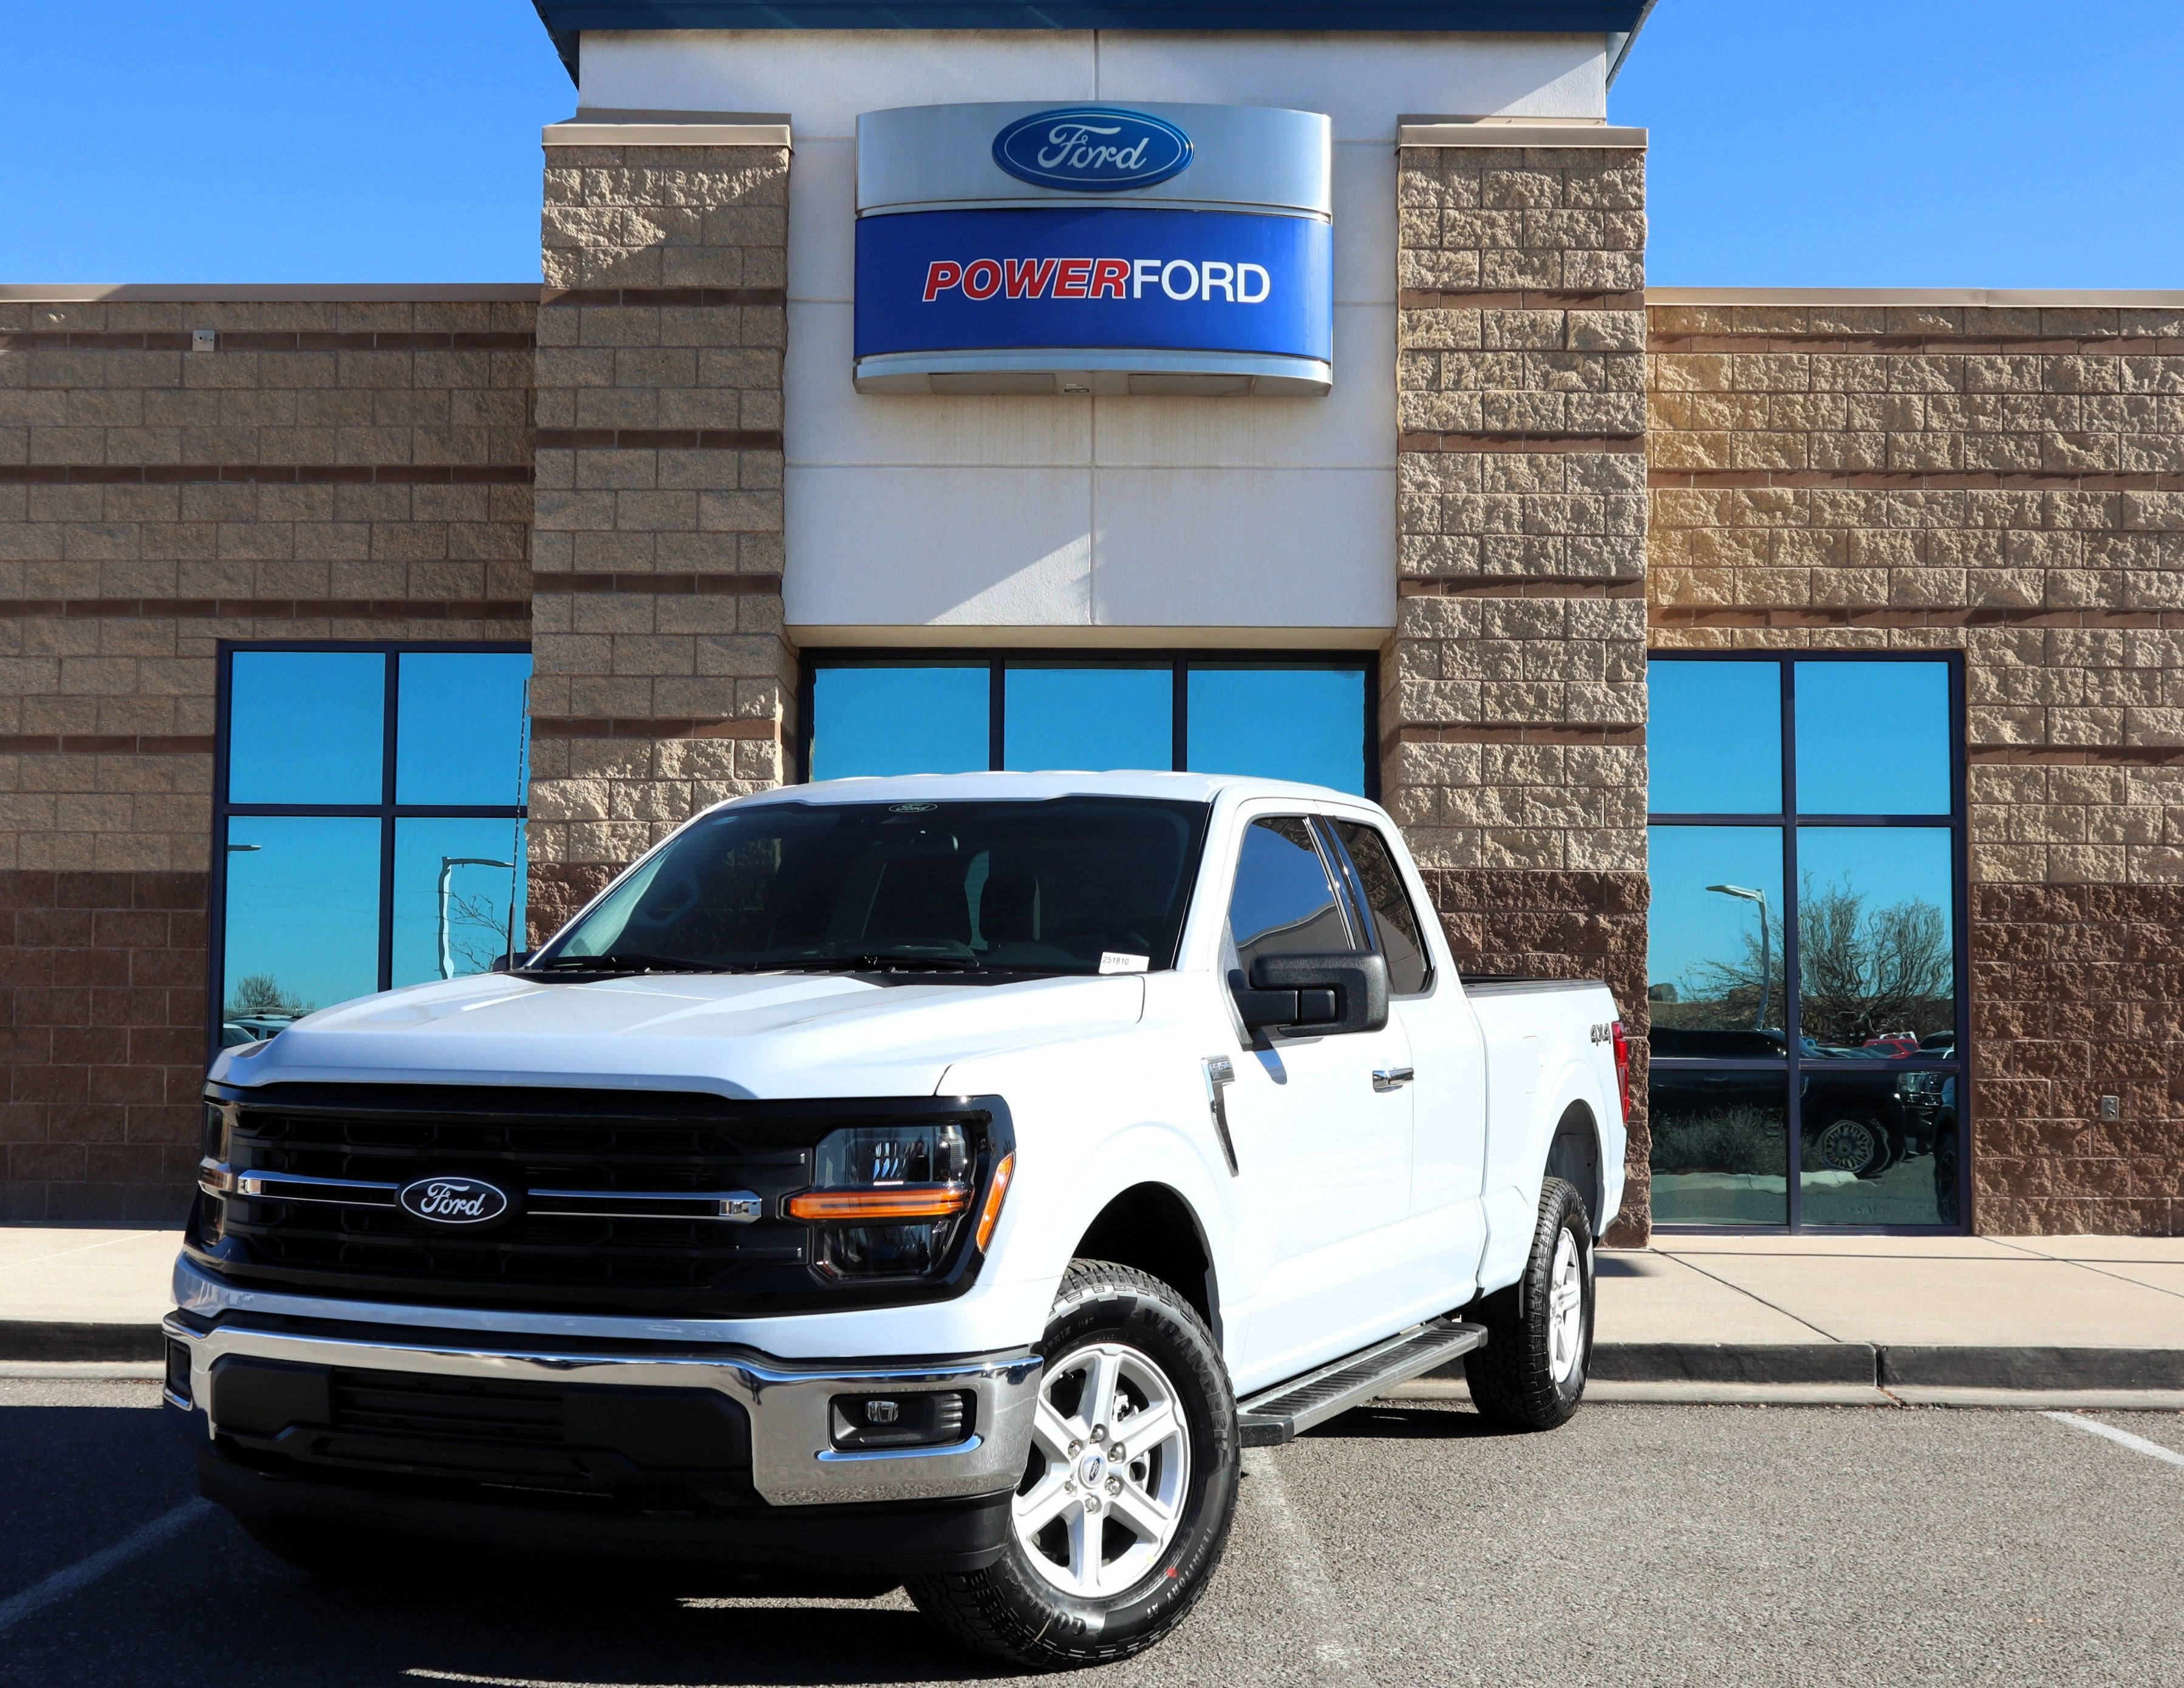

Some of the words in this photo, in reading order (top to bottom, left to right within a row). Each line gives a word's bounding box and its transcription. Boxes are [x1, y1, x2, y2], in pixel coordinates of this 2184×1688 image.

[1037, 123, 1148, 169] Ford
[1102, 956, 1130, 965] 251810
[420, 1182, 486, 1216] Ford
[1142, 1307, 1230, 1454] WRANGLER
